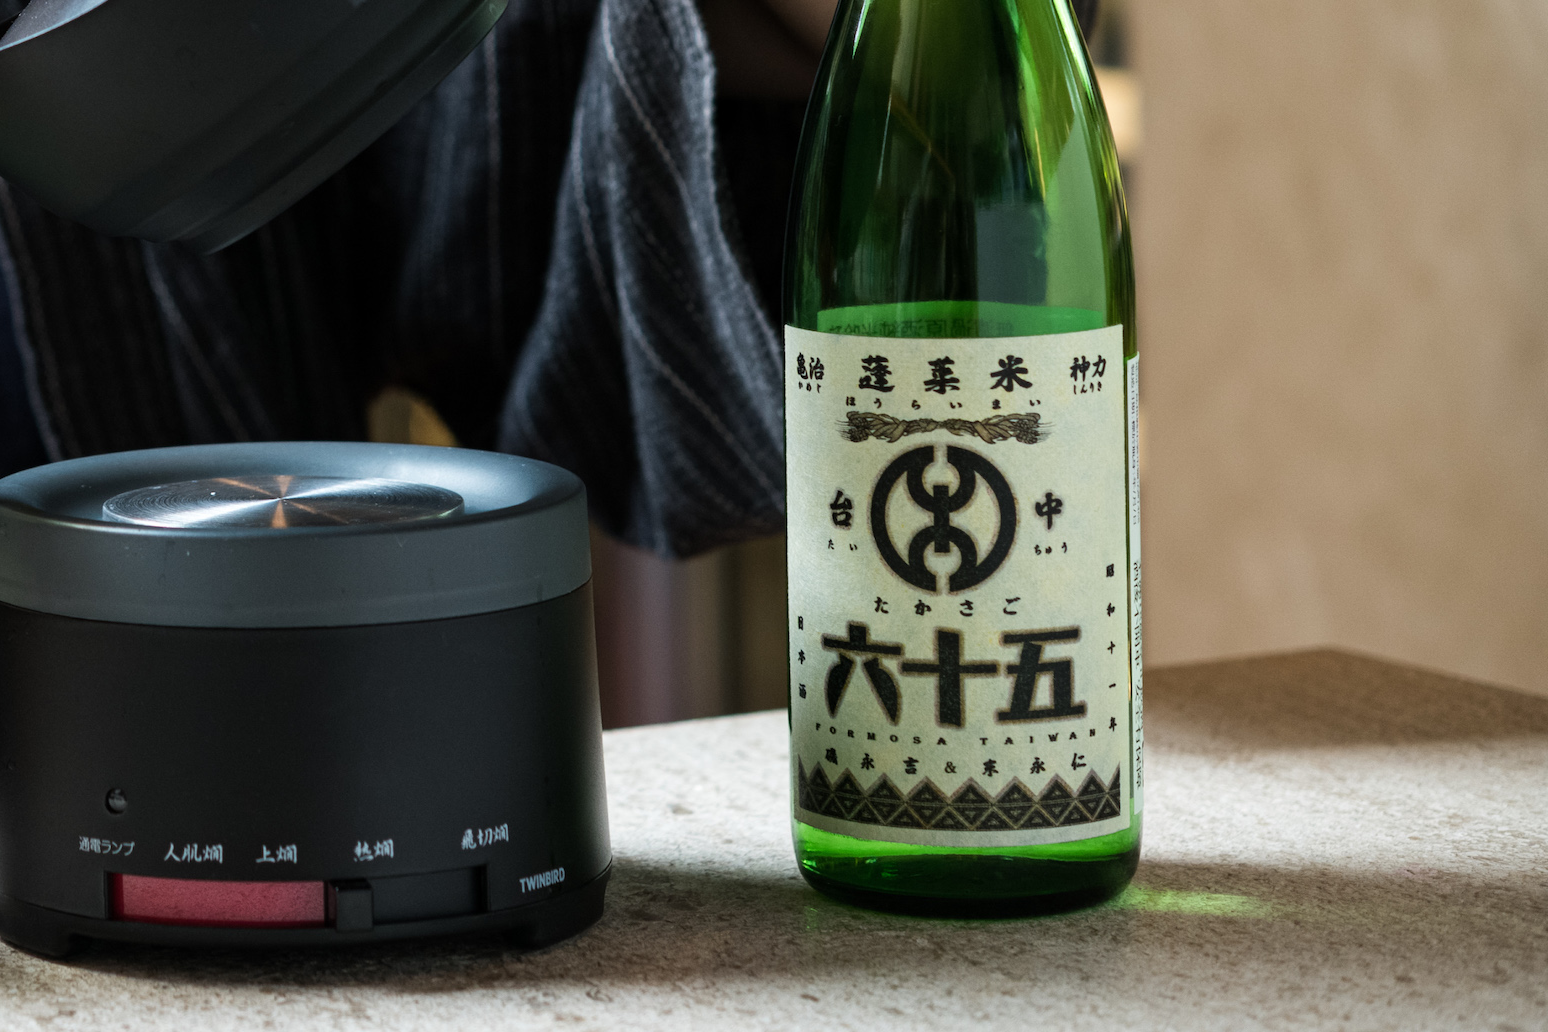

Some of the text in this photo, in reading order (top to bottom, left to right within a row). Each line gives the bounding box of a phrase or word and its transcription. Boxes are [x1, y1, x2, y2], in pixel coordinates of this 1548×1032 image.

[1069, 354, 1107, 382] 神力
[829, 489, 1064, 531] 台 中
[873, 596, 1021, 618] たかさご
[820, 621, 1088, 729] 六十五
[815, 722, 1096, 746] FORMOSA TAIWAN
[78, 835, 136, 856] 通電ランプ
[519, 867, 566, 894] TWINBIRD
